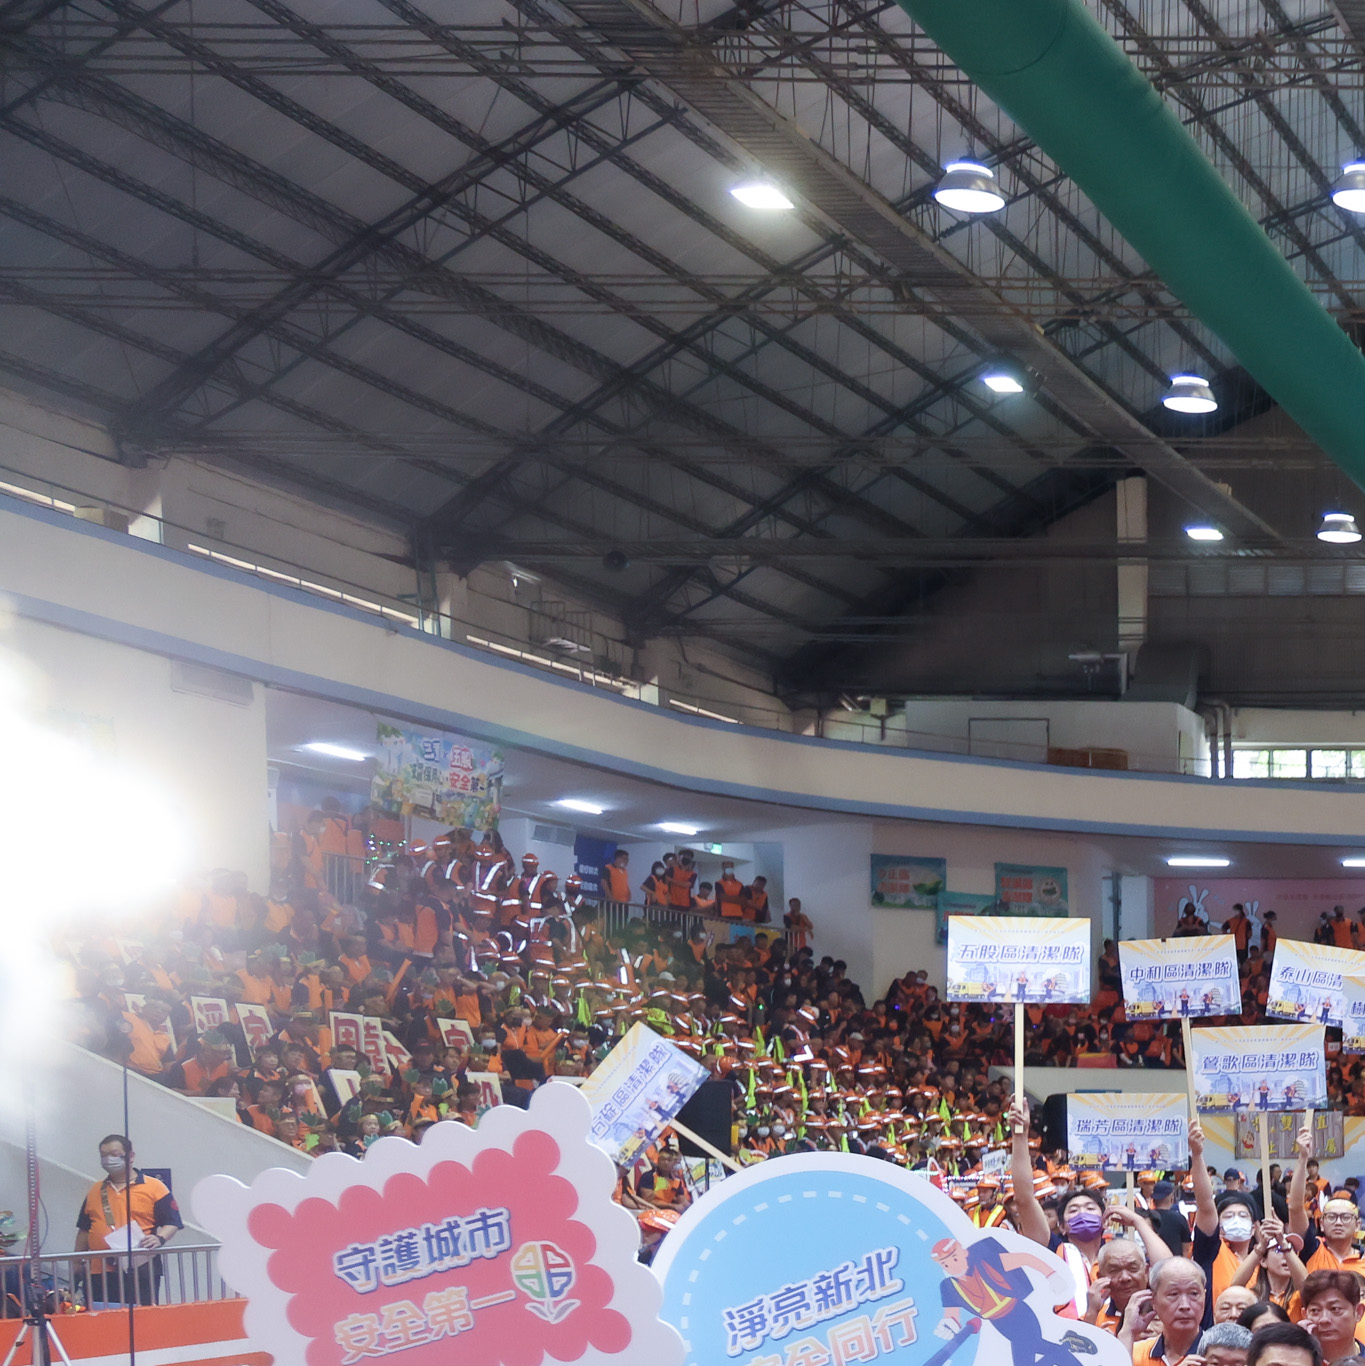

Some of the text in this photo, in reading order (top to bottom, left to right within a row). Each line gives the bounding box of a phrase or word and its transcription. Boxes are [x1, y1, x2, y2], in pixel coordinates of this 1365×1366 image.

[958, 944, 1084, 963] 五股區清潔隊
[1129, 960, 1231, 983] 中和區清潔隊
[1202, 1051, 1319, 1073] 鶯歌區清潔隊
[1076, 1118, 1183, 1136] 瑞芳區清潔隊
[335, 1210, 508, 1290] 守護城市
[724, 1246, 903, 1354] 淨亮新北
[334, 1287, 516, 1365] 安全第一
